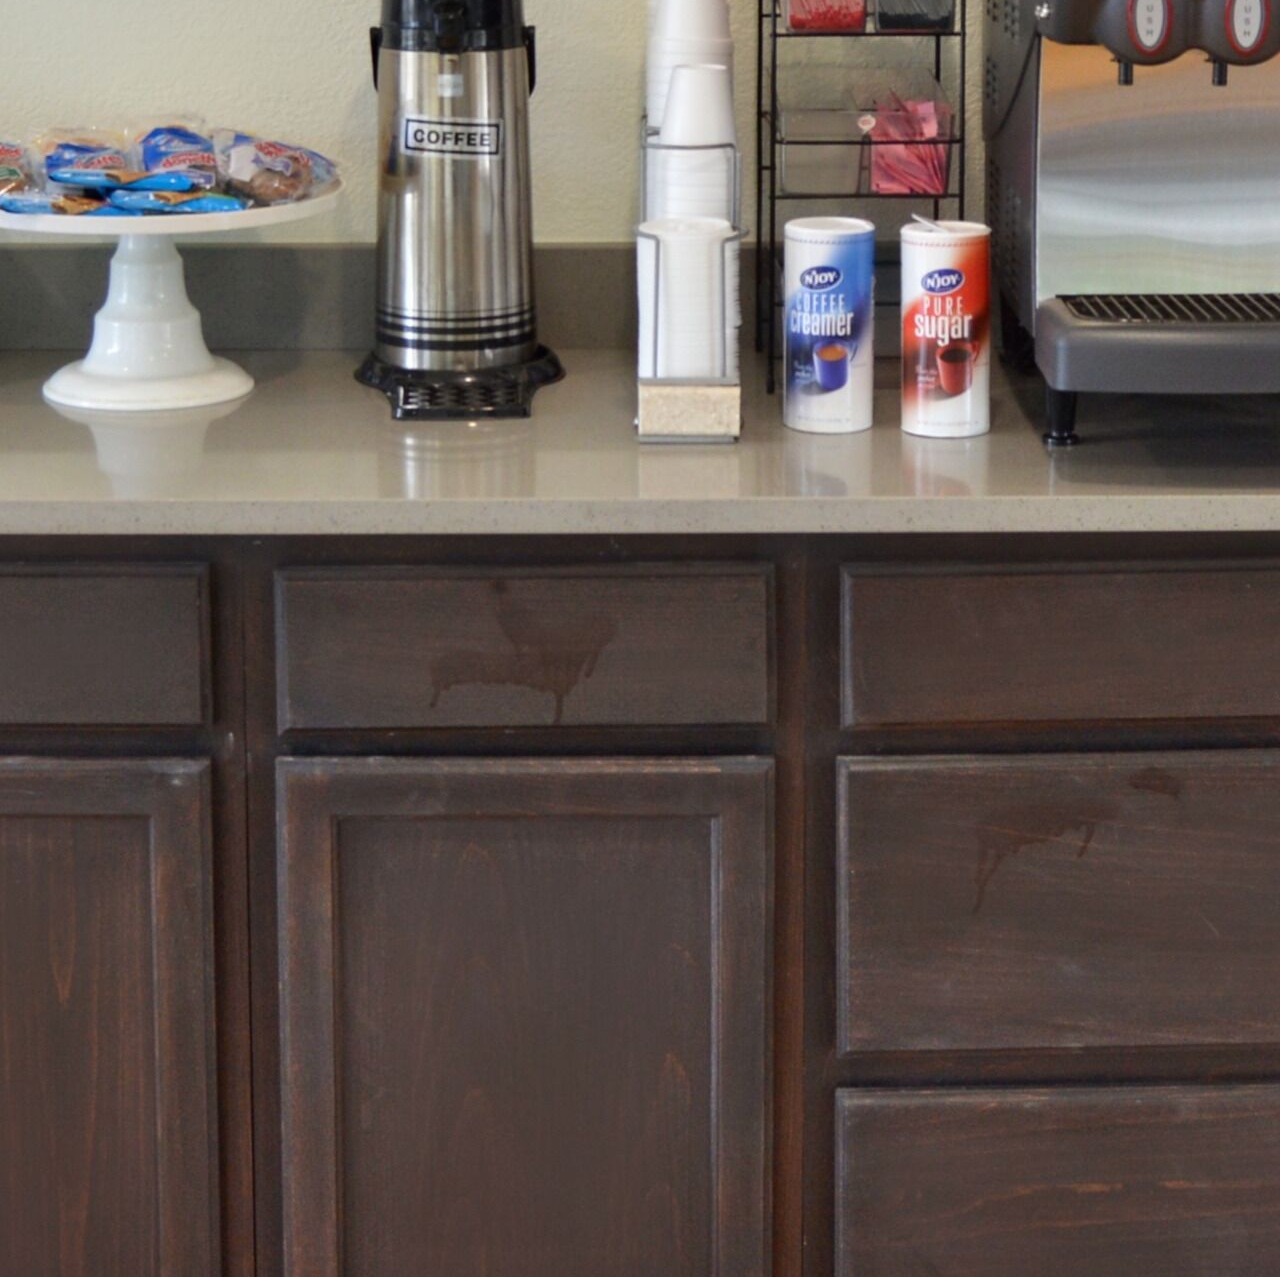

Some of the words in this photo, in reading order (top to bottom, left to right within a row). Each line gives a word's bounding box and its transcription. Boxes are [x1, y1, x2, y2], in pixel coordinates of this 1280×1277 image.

[413, 128, 492, 147] COFFEE
[796, 293, 845, 312] COFFEE
[923, 295, 963, 315] PURE
[790, 310, 854, 336] creamer
[914, 314, 973, 347] sugar
